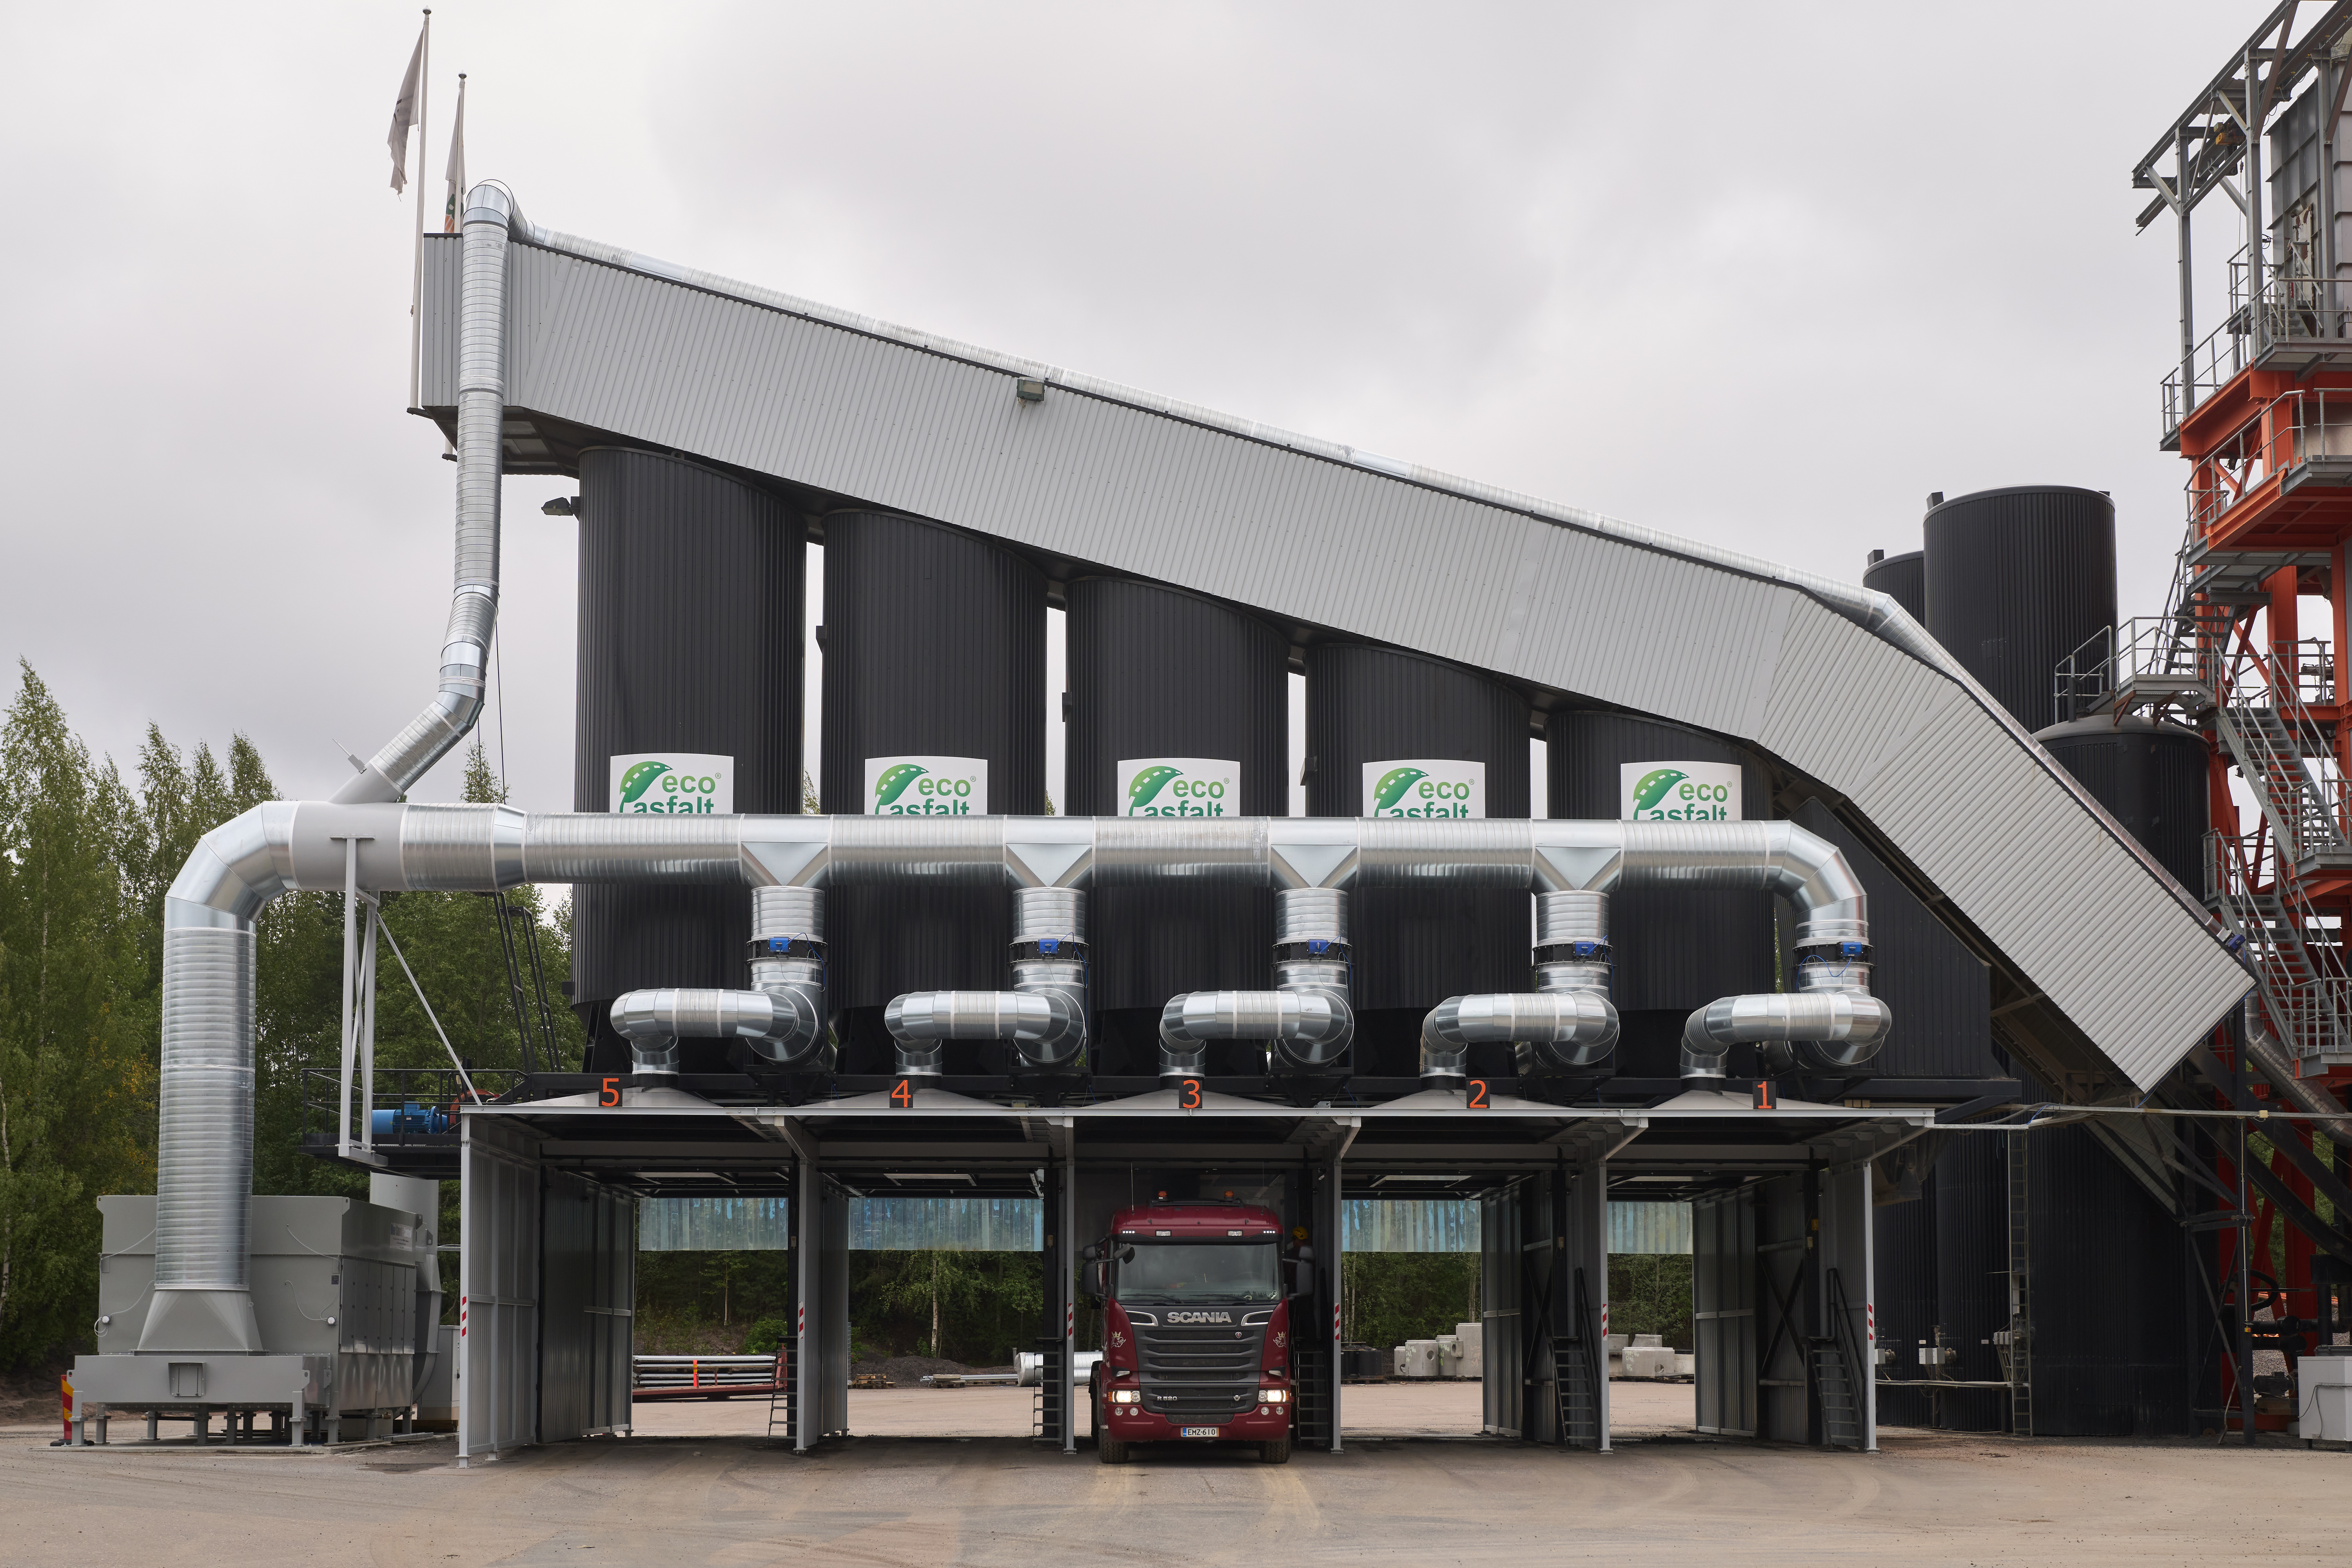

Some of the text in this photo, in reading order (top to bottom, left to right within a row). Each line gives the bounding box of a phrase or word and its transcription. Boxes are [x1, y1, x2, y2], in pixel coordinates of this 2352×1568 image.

[602, 1078, 619, 1107] 5
[891, 1080, 911, 1107] 4
[1183, 1080, 1200, 1108] 3
[1470, 1080, 1487, 1108] 2
[1757, 1081, 1772, 1109] 1
[1167, 1312, 1232, 1323] SCANIA
